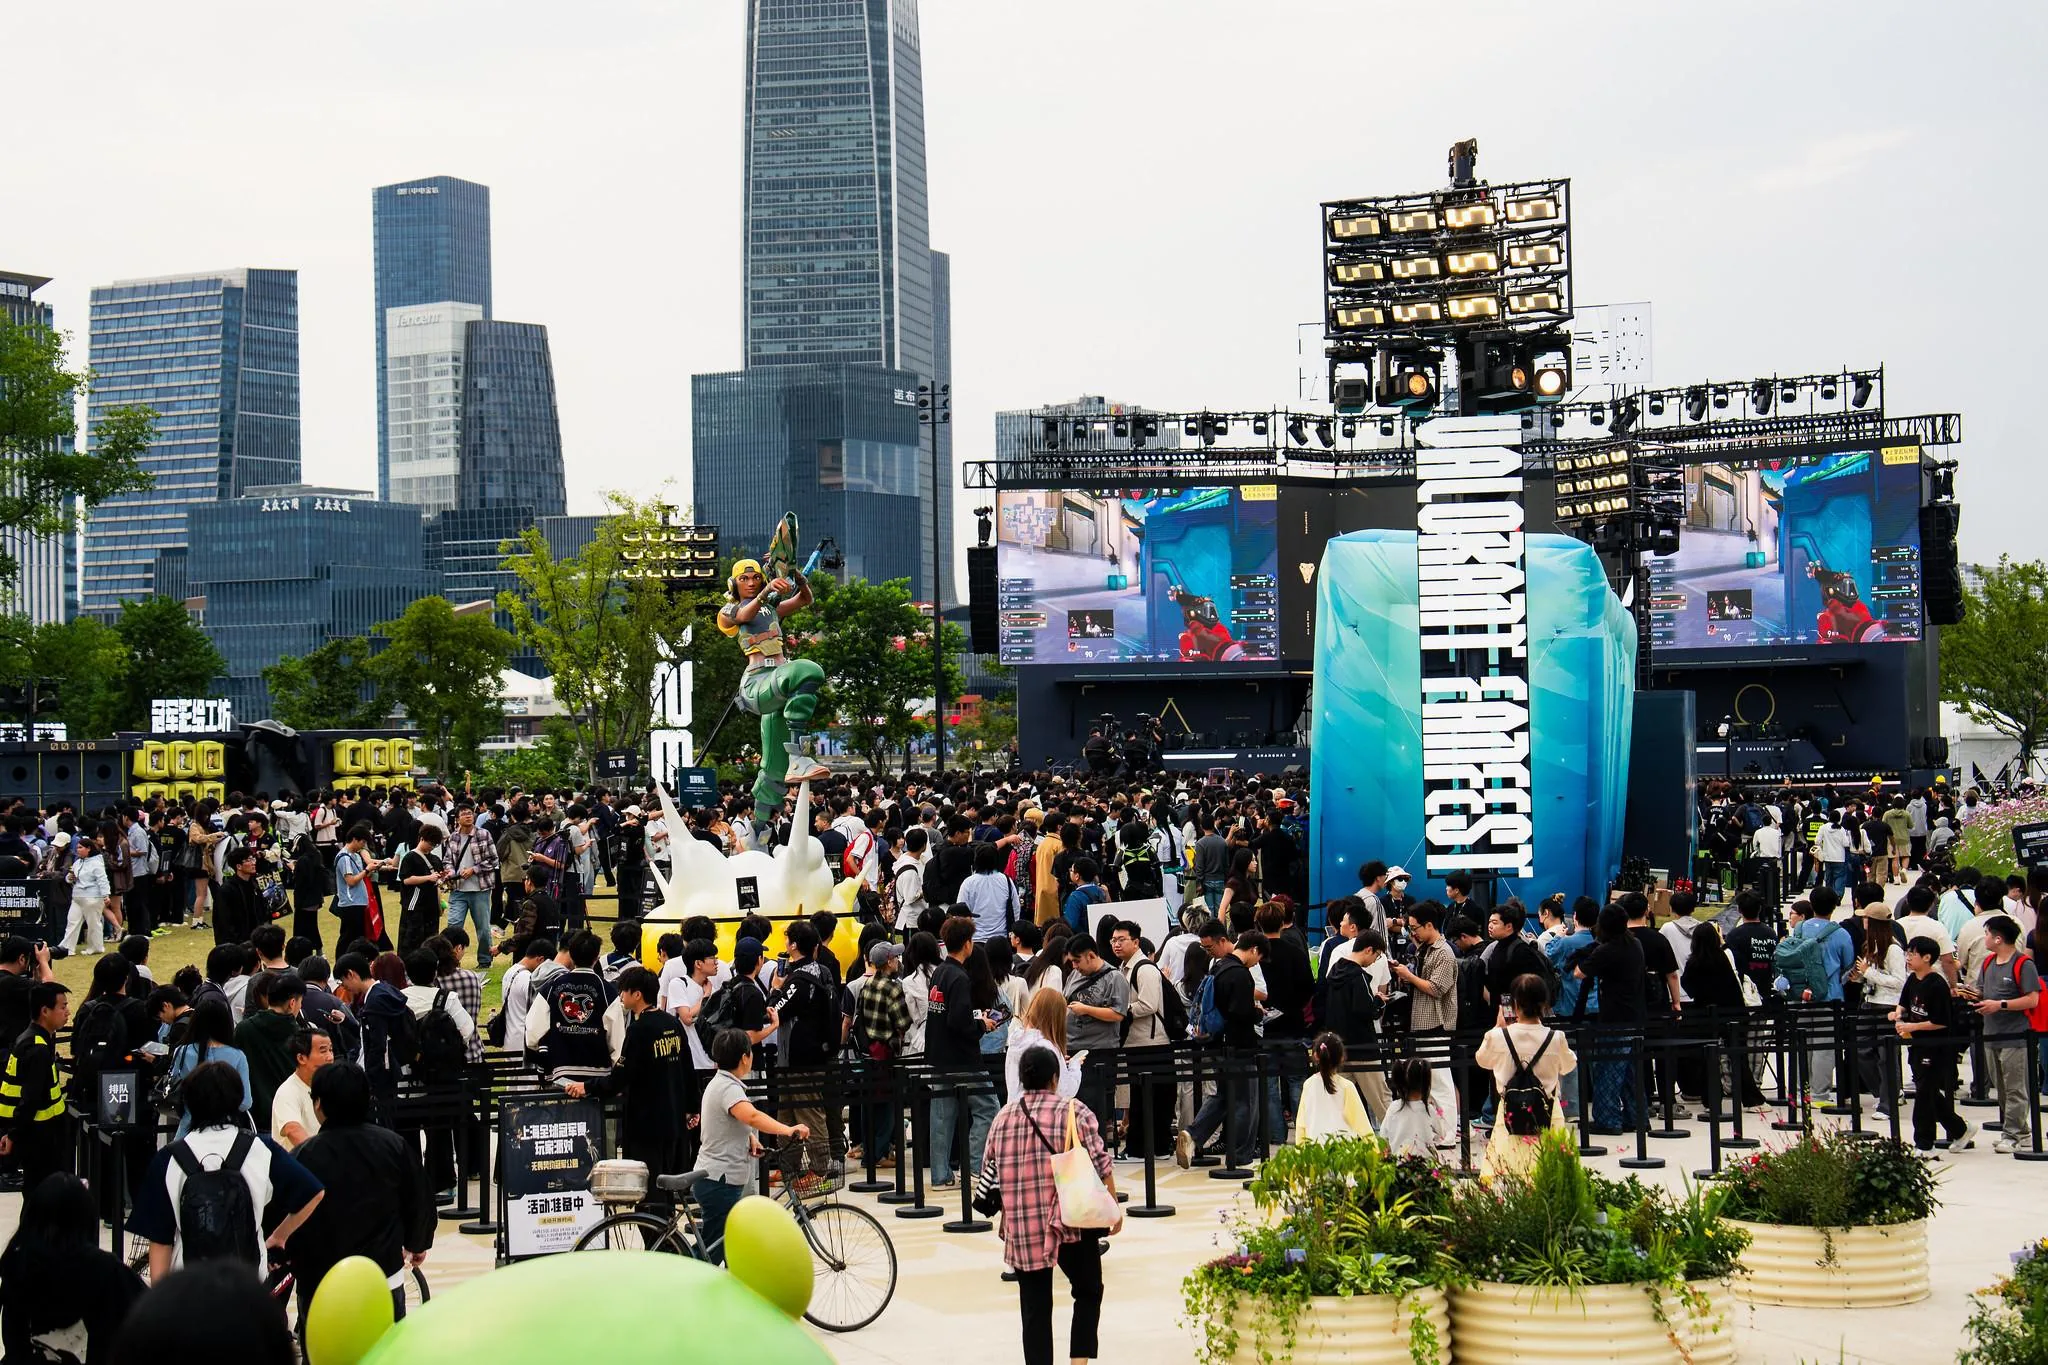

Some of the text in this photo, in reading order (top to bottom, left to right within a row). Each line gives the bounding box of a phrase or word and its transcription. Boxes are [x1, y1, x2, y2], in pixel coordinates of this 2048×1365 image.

[396, 311, 442, 328] Tencent
[1085, 650, 1093, 658] 90
[1416, 414, 1534, 879] VALORANT FANFEST
[152, 698, 231, 733] 冠军彩绘工坊
[608, 760, 626, 769] 队尾
[109, 1083, 129, 1095] 排队
[109, 1093, 129, 1104] 入口
[520, 1121, 587, 1141] 上海全球冠军赛
[534, 1138, 574, 1156] 玩家派对
[527, 1195, 584, 1215] 活动准备中
